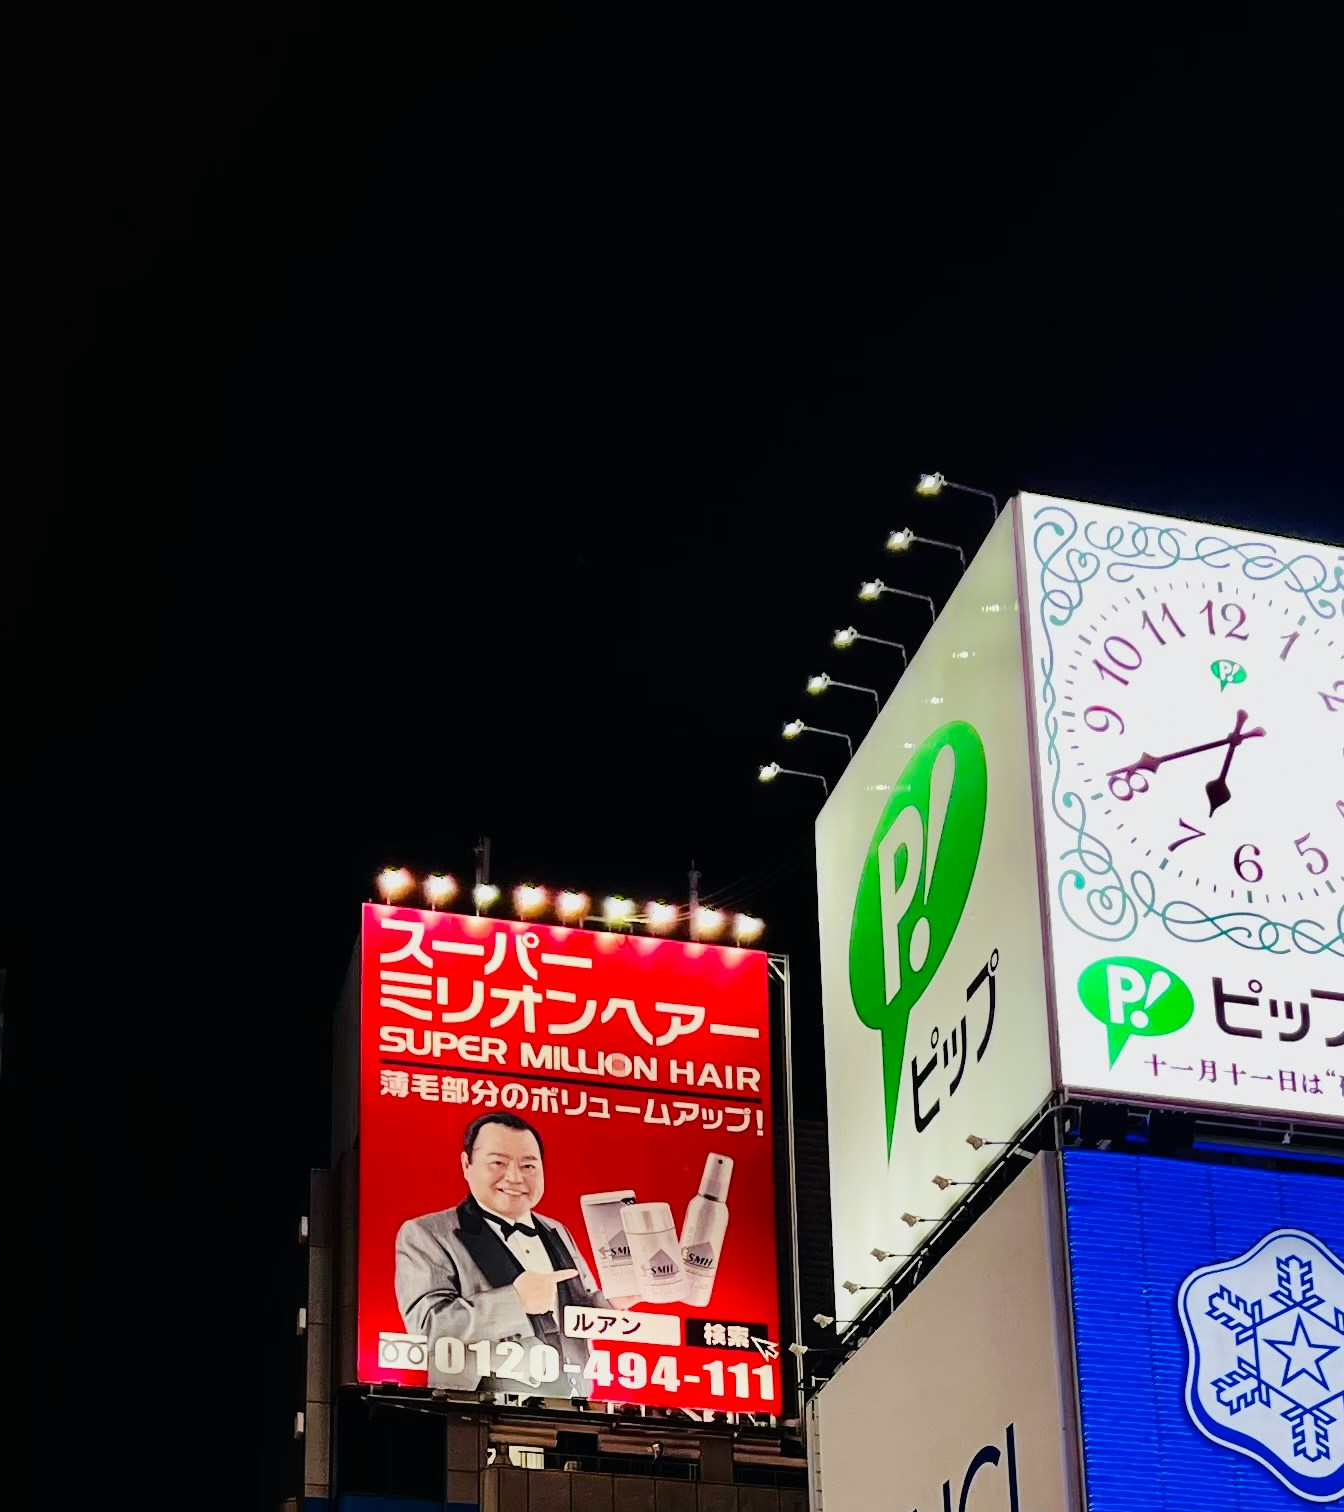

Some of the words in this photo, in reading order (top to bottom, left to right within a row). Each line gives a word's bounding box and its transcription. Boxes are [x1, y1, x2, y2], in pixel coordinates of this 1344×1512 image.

[1141, 602, 1187, 646] 11
[1199, 599, 1251, 641] 12
[1091, 635, 1144, 687] 10
[1278, 631, 1301, 662] 1
[1082, 704, 1126, 735] 9
[1107, 766, 1150, 802] 8
[1167, 817, 1207, 853] 7
[1293, 832, 1330, 876] 5
[1233, 843, 1265, 883] 6
[379, 917, 593, 980] スーパー
[379, 969, 761, 1047] ミリオンヘアー
[1106, 963, 1173, 1030] P!
[379, 1026, 508, 1065] SUPER
[519, 1041, 659, 1083] MILLION
[669, 1058, 762, 1093] HAIR
[910, 947, 1000, 1134] ピップ
[379, 1069, 765, 1138] 薄毛部分のボリュームアップ!
[571, 1312, 643, 1337] ルアン
[702, 1321, 754, 1349] 検索
[433, 1336, 776, 1401] 0120-494-111
